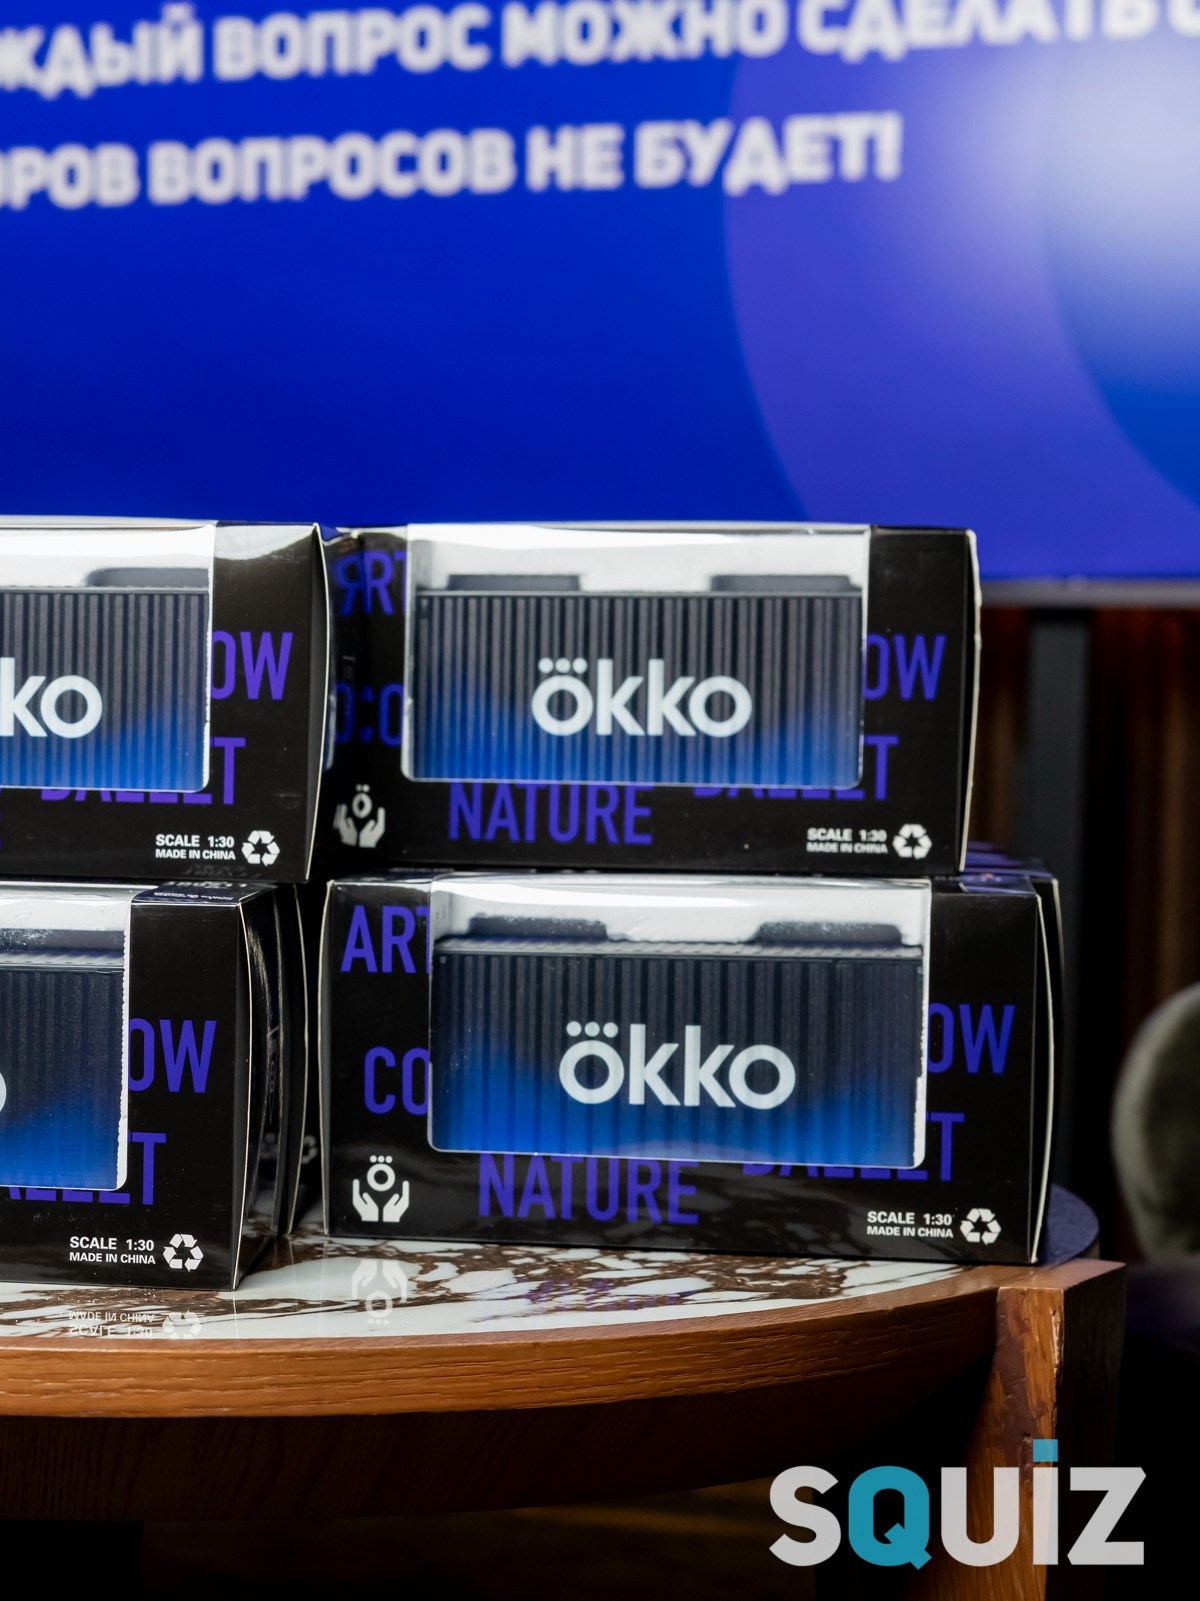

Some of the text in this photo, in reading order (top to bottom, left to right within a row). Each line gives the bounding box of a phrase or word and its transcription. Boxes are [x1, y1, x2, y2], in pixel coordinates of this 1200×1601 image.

[212, 3, 492, 82] ВОПРОС
[501, 0, 788, 69] МОЖНО
[147, 126, 517, 205] ВОПРОСОВ
[525, 122, 625, 193] НЕ
[632, 110, 904, 197] БУДЕТ!
[449, 781, 653, 845] NATURE
[155, 833, 235, 848] SCALE 1:30
[807, 827, 888, 842] SCALE 1:30
[155, 848, 236, 860] MADE IN CHINA
[806, 842, 888, 854] MADE IN CHINA
[478, 1152, 700, 1225] NATURE
[867, 1210, 953, 1226] SCALE 1:30
[866, 1226, 954, 1238] MADE IN CHINA
[69, 1236, 155, 1251] SCALE 1:30
[69, 1251, 156, 1265] MADE IN CHINA
